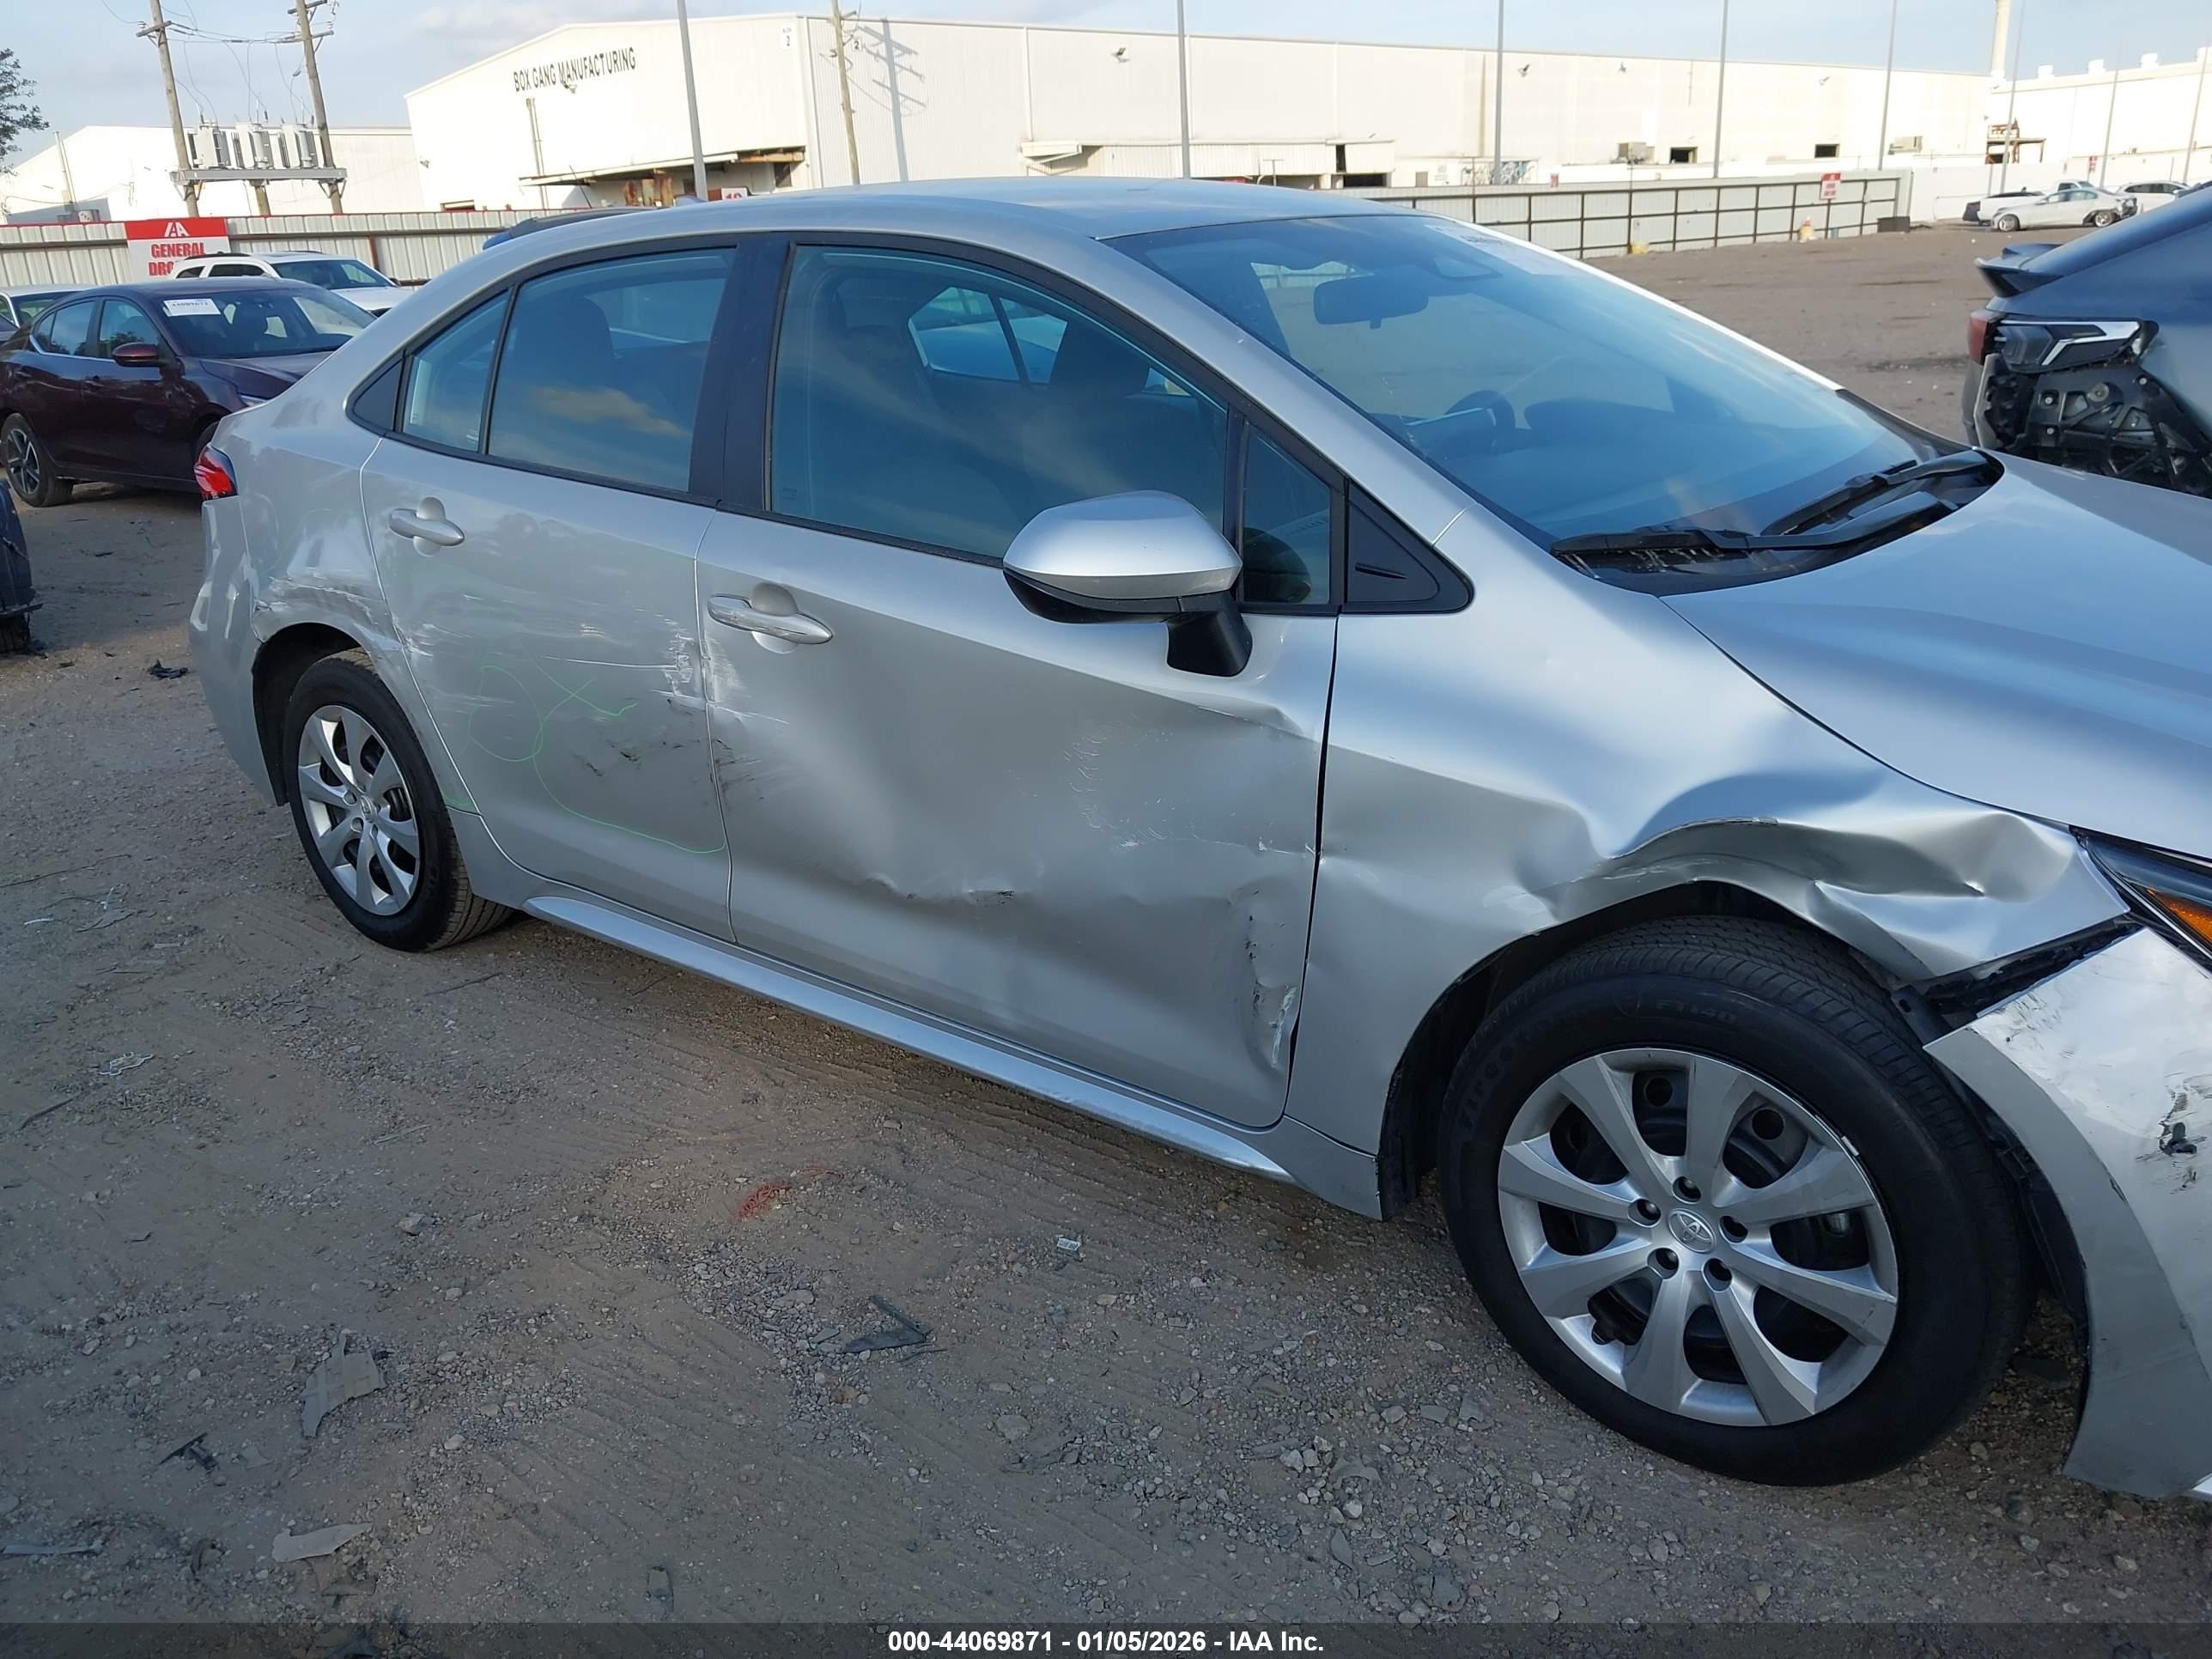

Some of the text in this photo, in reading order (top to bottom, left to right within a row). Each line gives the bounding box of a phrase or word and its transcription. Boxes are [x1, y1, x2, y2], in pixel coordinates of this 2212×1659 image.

[514, 46, 636, 92] BOX GANG MANUFACTURING
[150, 242, 205, 258] GENERAL
[148, 261, 174, 276] DRO
